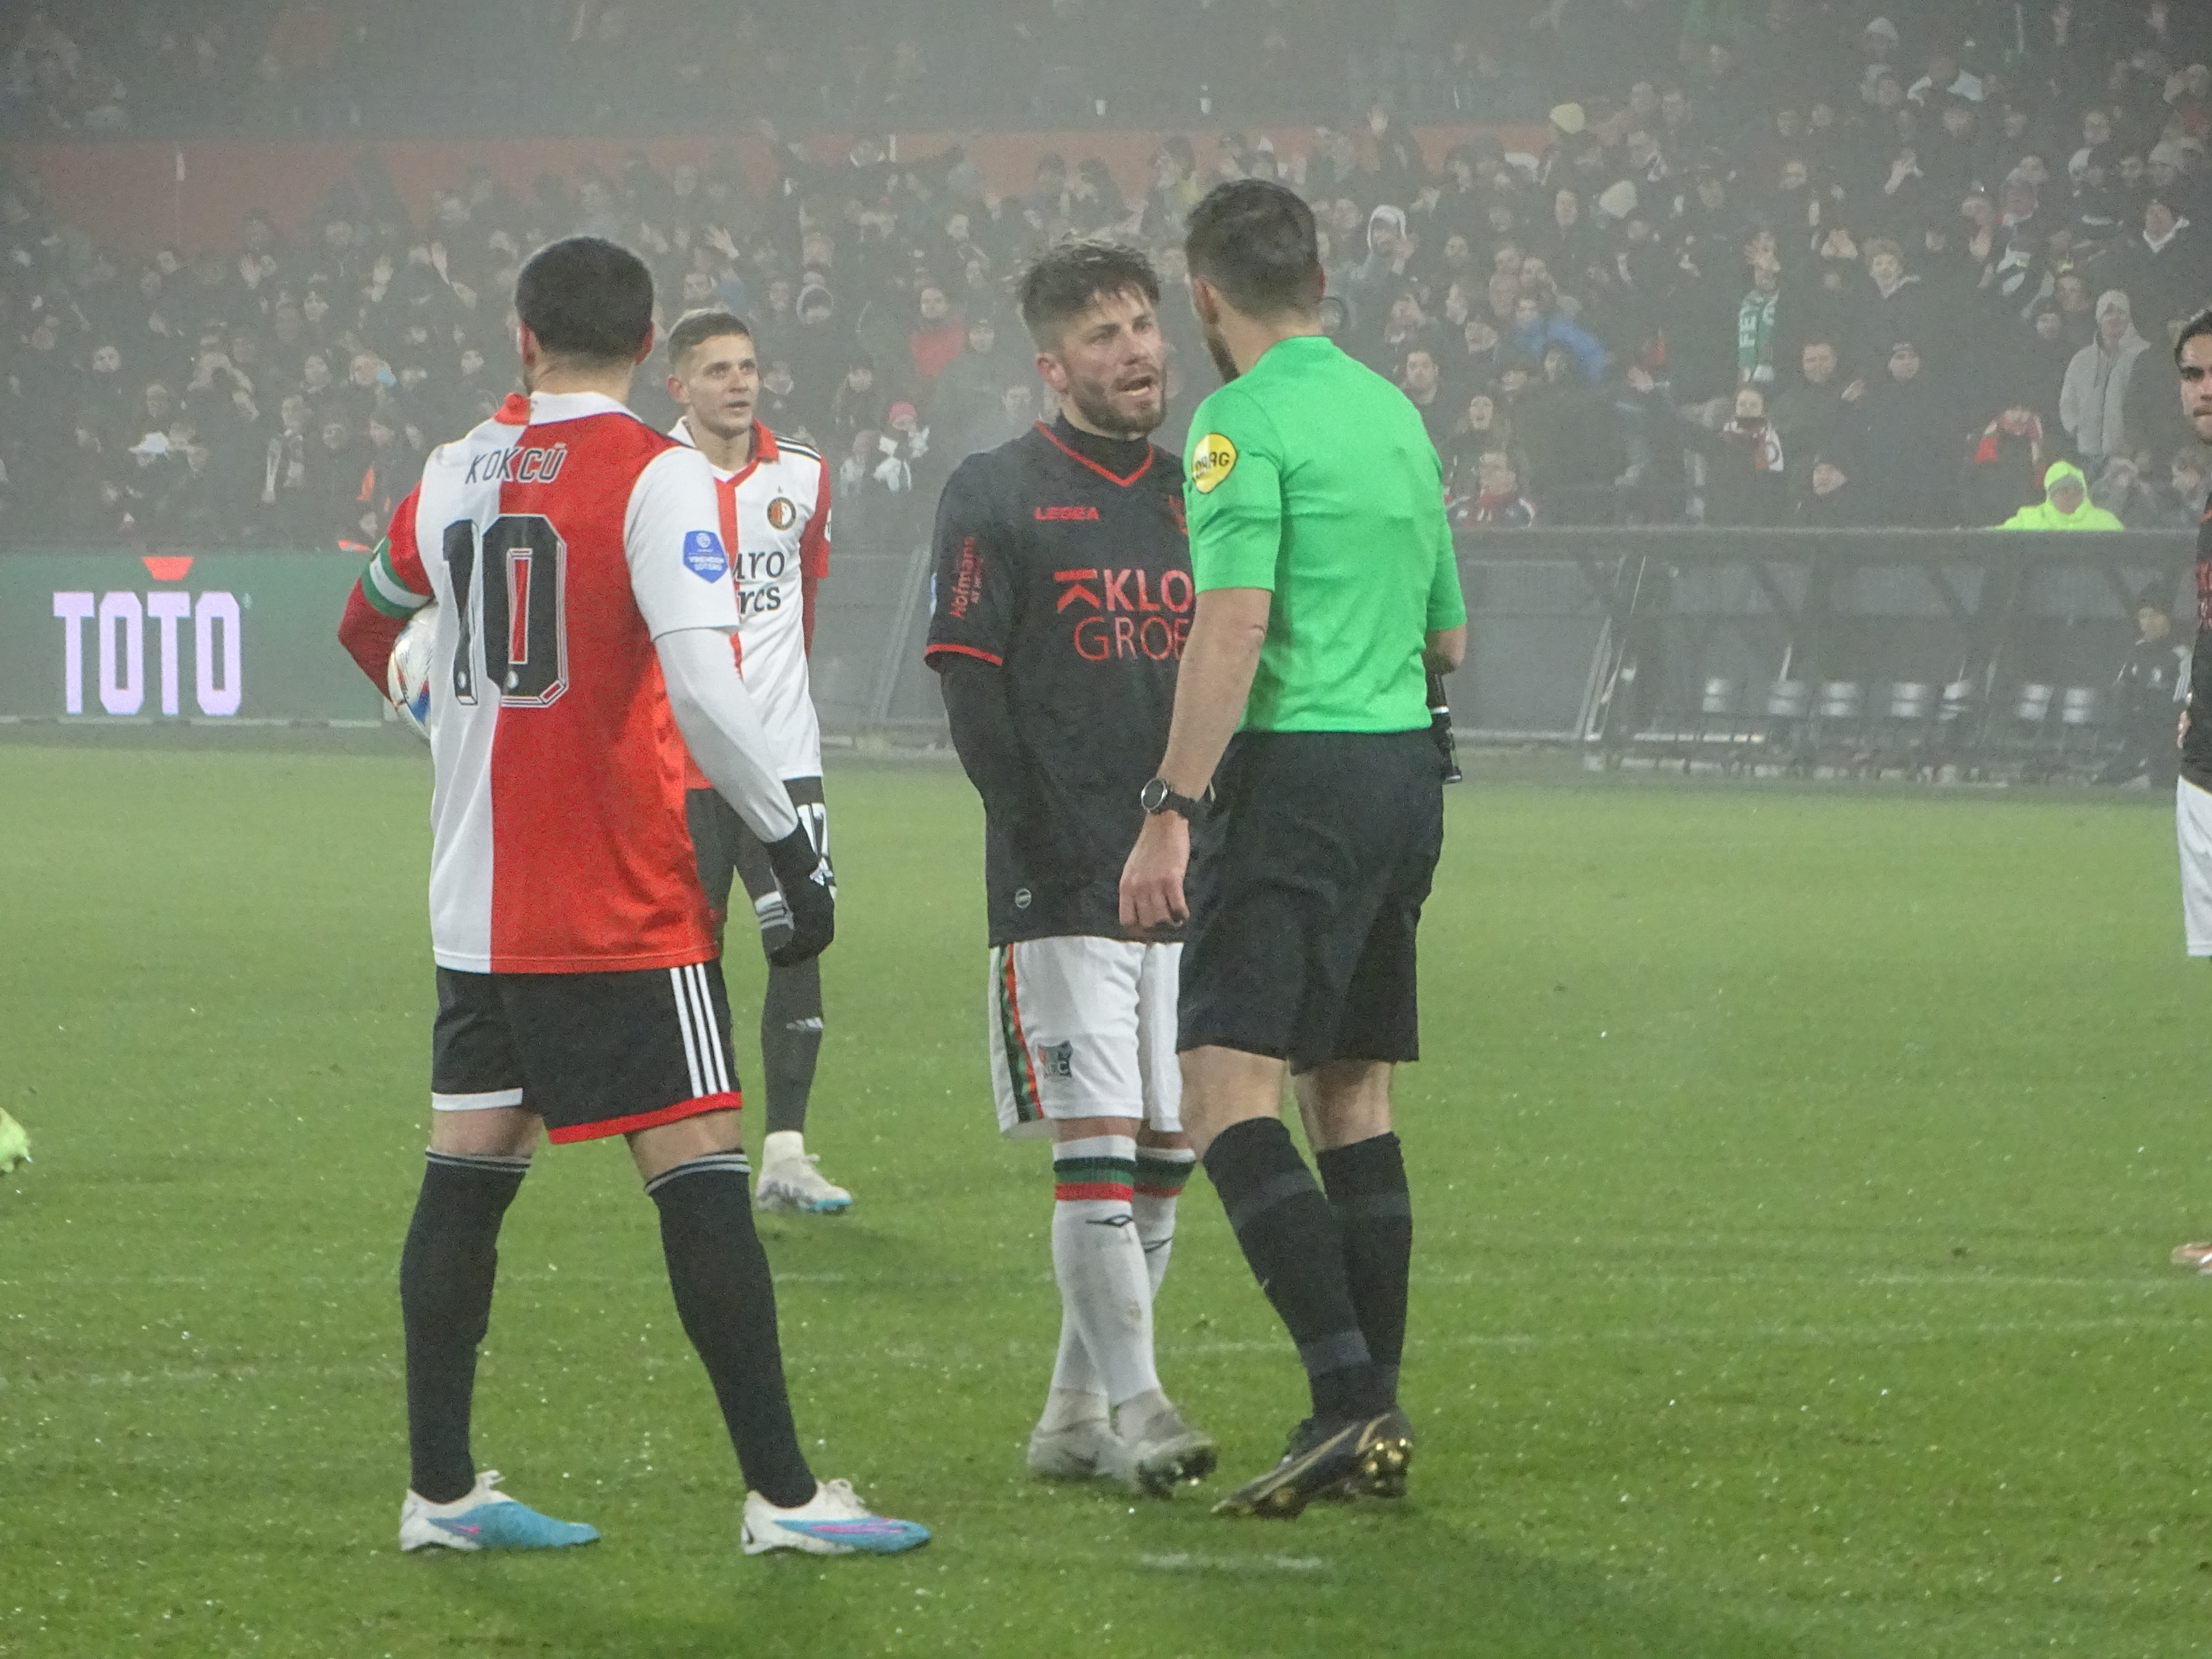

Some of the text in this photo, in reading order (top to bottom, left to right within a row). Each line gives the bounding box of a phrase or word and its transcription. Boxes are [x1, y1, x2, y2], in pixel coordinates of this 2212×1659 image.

[442, 513, 569, 708] 10
[1103, 568, 1193, 613] KLO
[53, 591, 241, 716] TOTO
[1073, 616, 1191, 661] GROE
